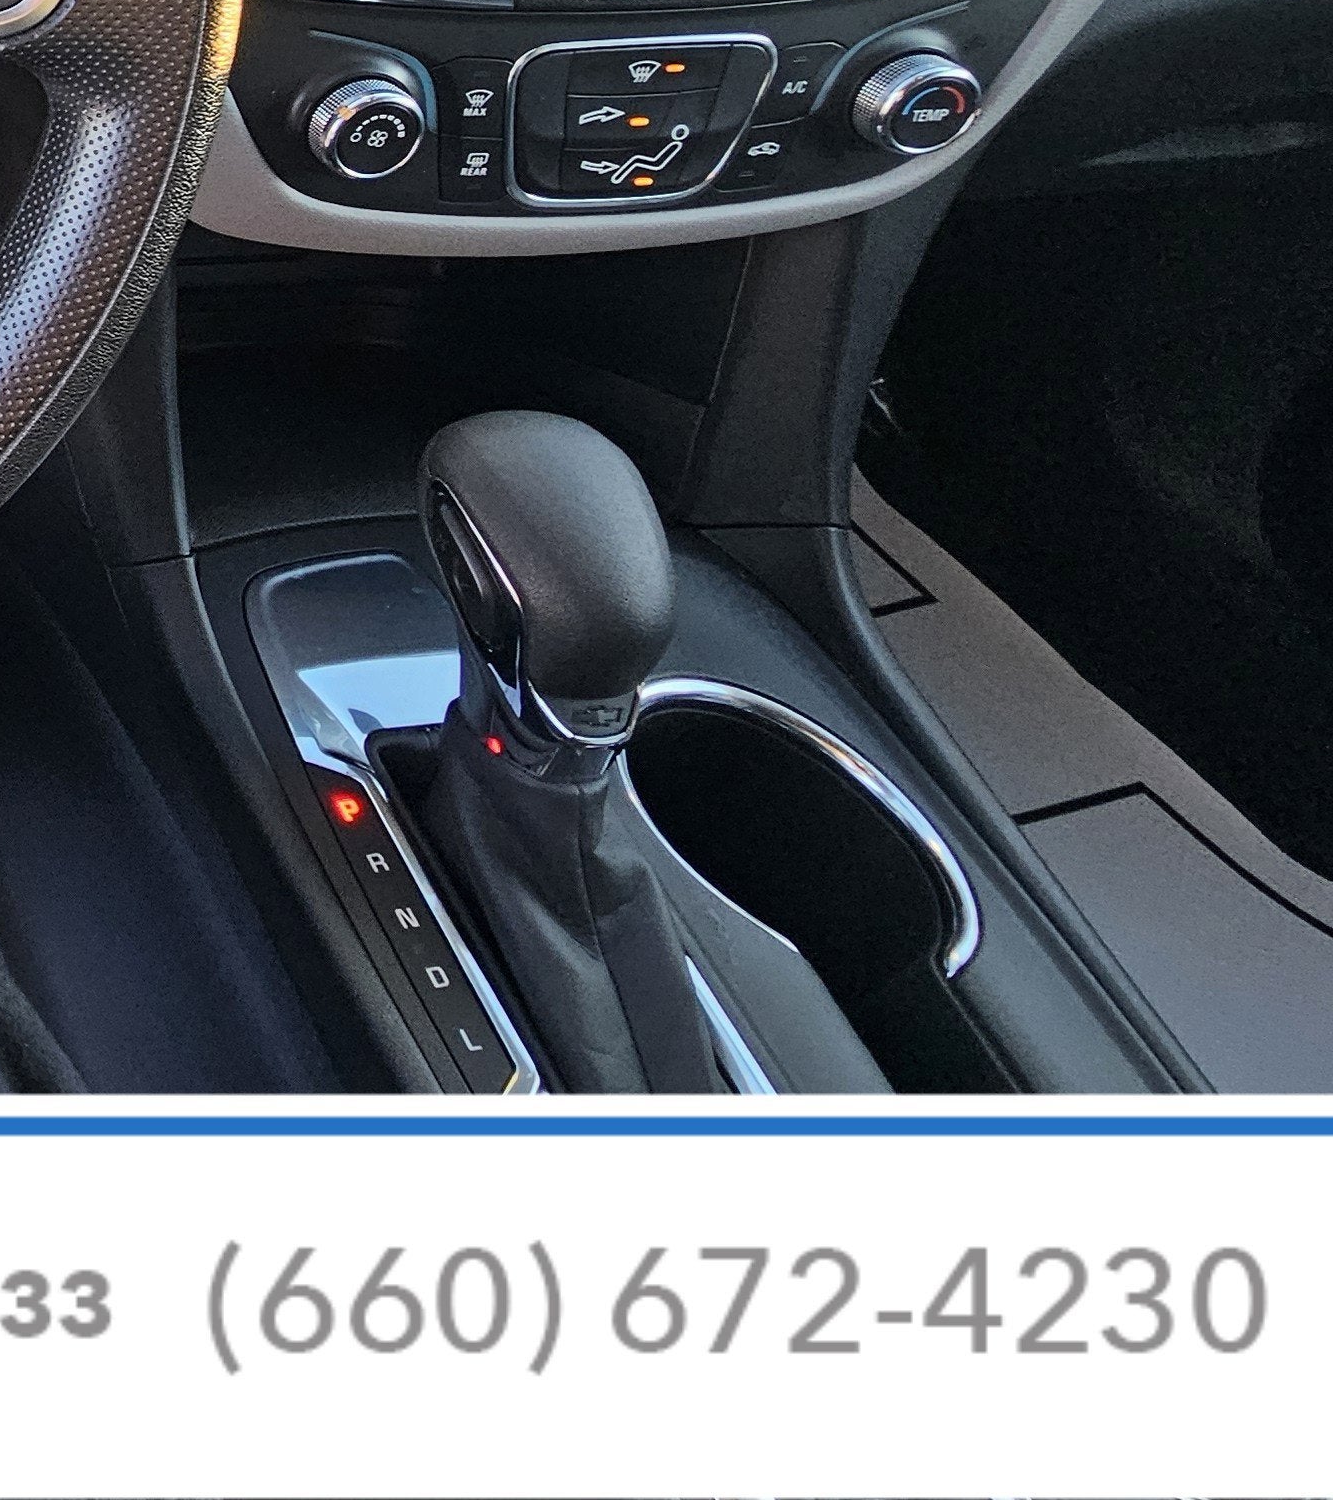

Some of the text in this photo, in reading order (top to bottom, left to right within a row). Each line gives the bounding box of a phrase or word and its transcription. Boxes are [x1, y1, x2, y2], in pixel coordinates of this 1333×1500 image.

[782, 80, 809, 95] A/C
[463, 108, 487, 117] MAX
[911, 108, 950, 123] TEMP
[460, 167, 488, 177] REAR
[334, 797, 361, 823] P
[365, 852, 391, 874] R
[394, 906, 421, 930] N
[425, 965, 450, 989] D
[459, 1027, 483, 1052] L
